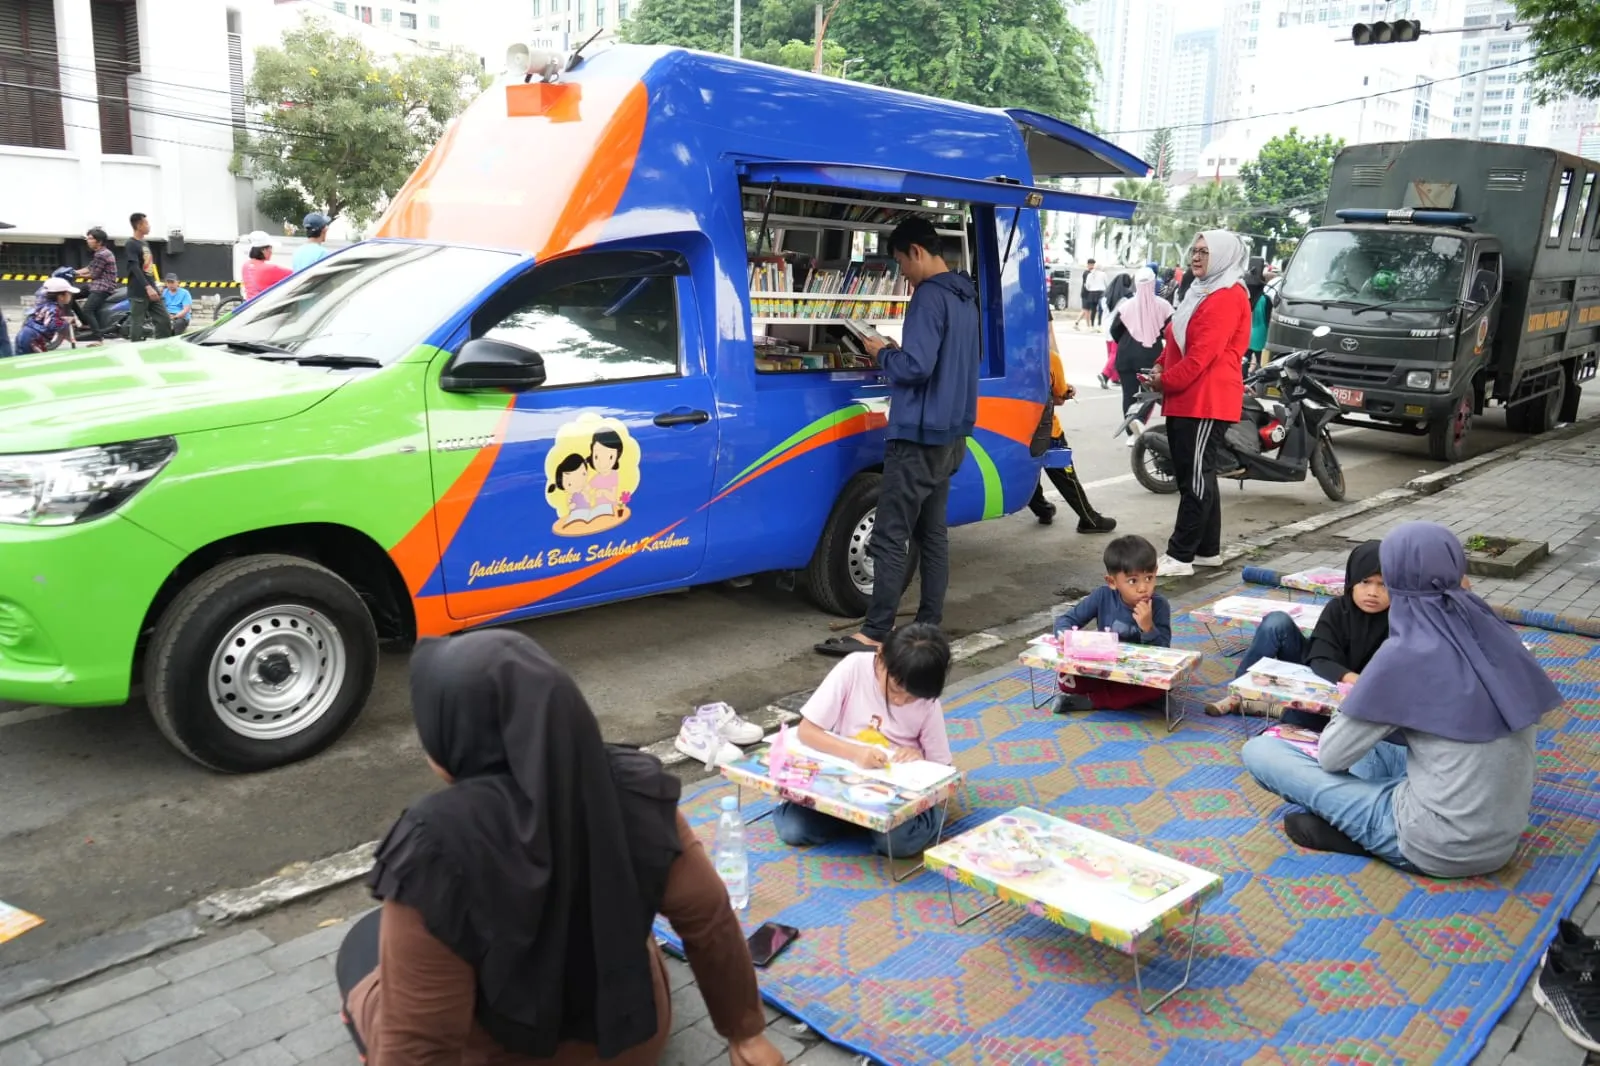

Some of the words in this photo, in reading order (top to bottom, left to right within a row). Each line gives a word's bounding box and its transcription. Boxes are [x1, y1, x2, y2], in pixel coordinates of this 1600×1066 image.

[1121, 242, 1195, 268] CITY
[467, 550, 543, 585] Jadikanlah
[547, 547, 581, 567] Buku
[585, 539, 639, 561] Sahabat
[640, 532, 690, 553] Karibmu
